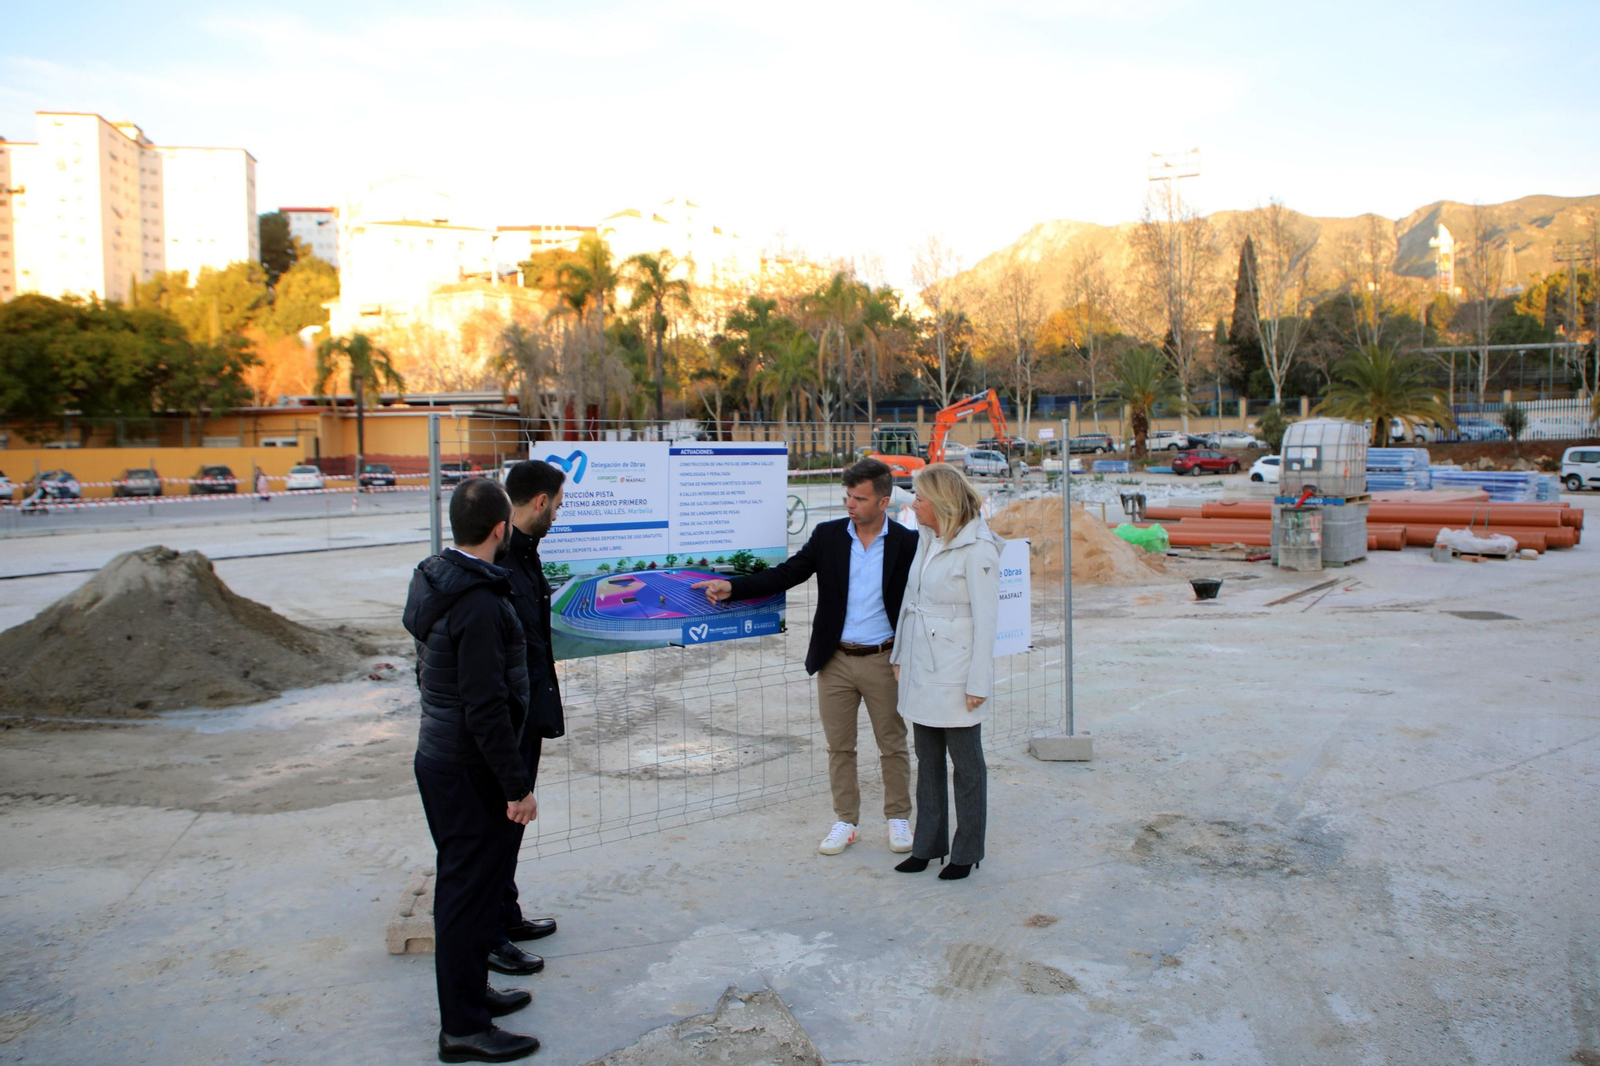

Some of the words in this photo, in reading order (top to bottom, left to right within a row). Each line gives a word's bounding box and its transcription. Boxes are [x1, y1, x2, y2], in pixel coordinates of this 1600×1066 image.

[1004, 568, 1022, 577] Obras
[999, 592, 1022, 600] MASFALT
[996, 630, 1024, 640] MARBELLA
